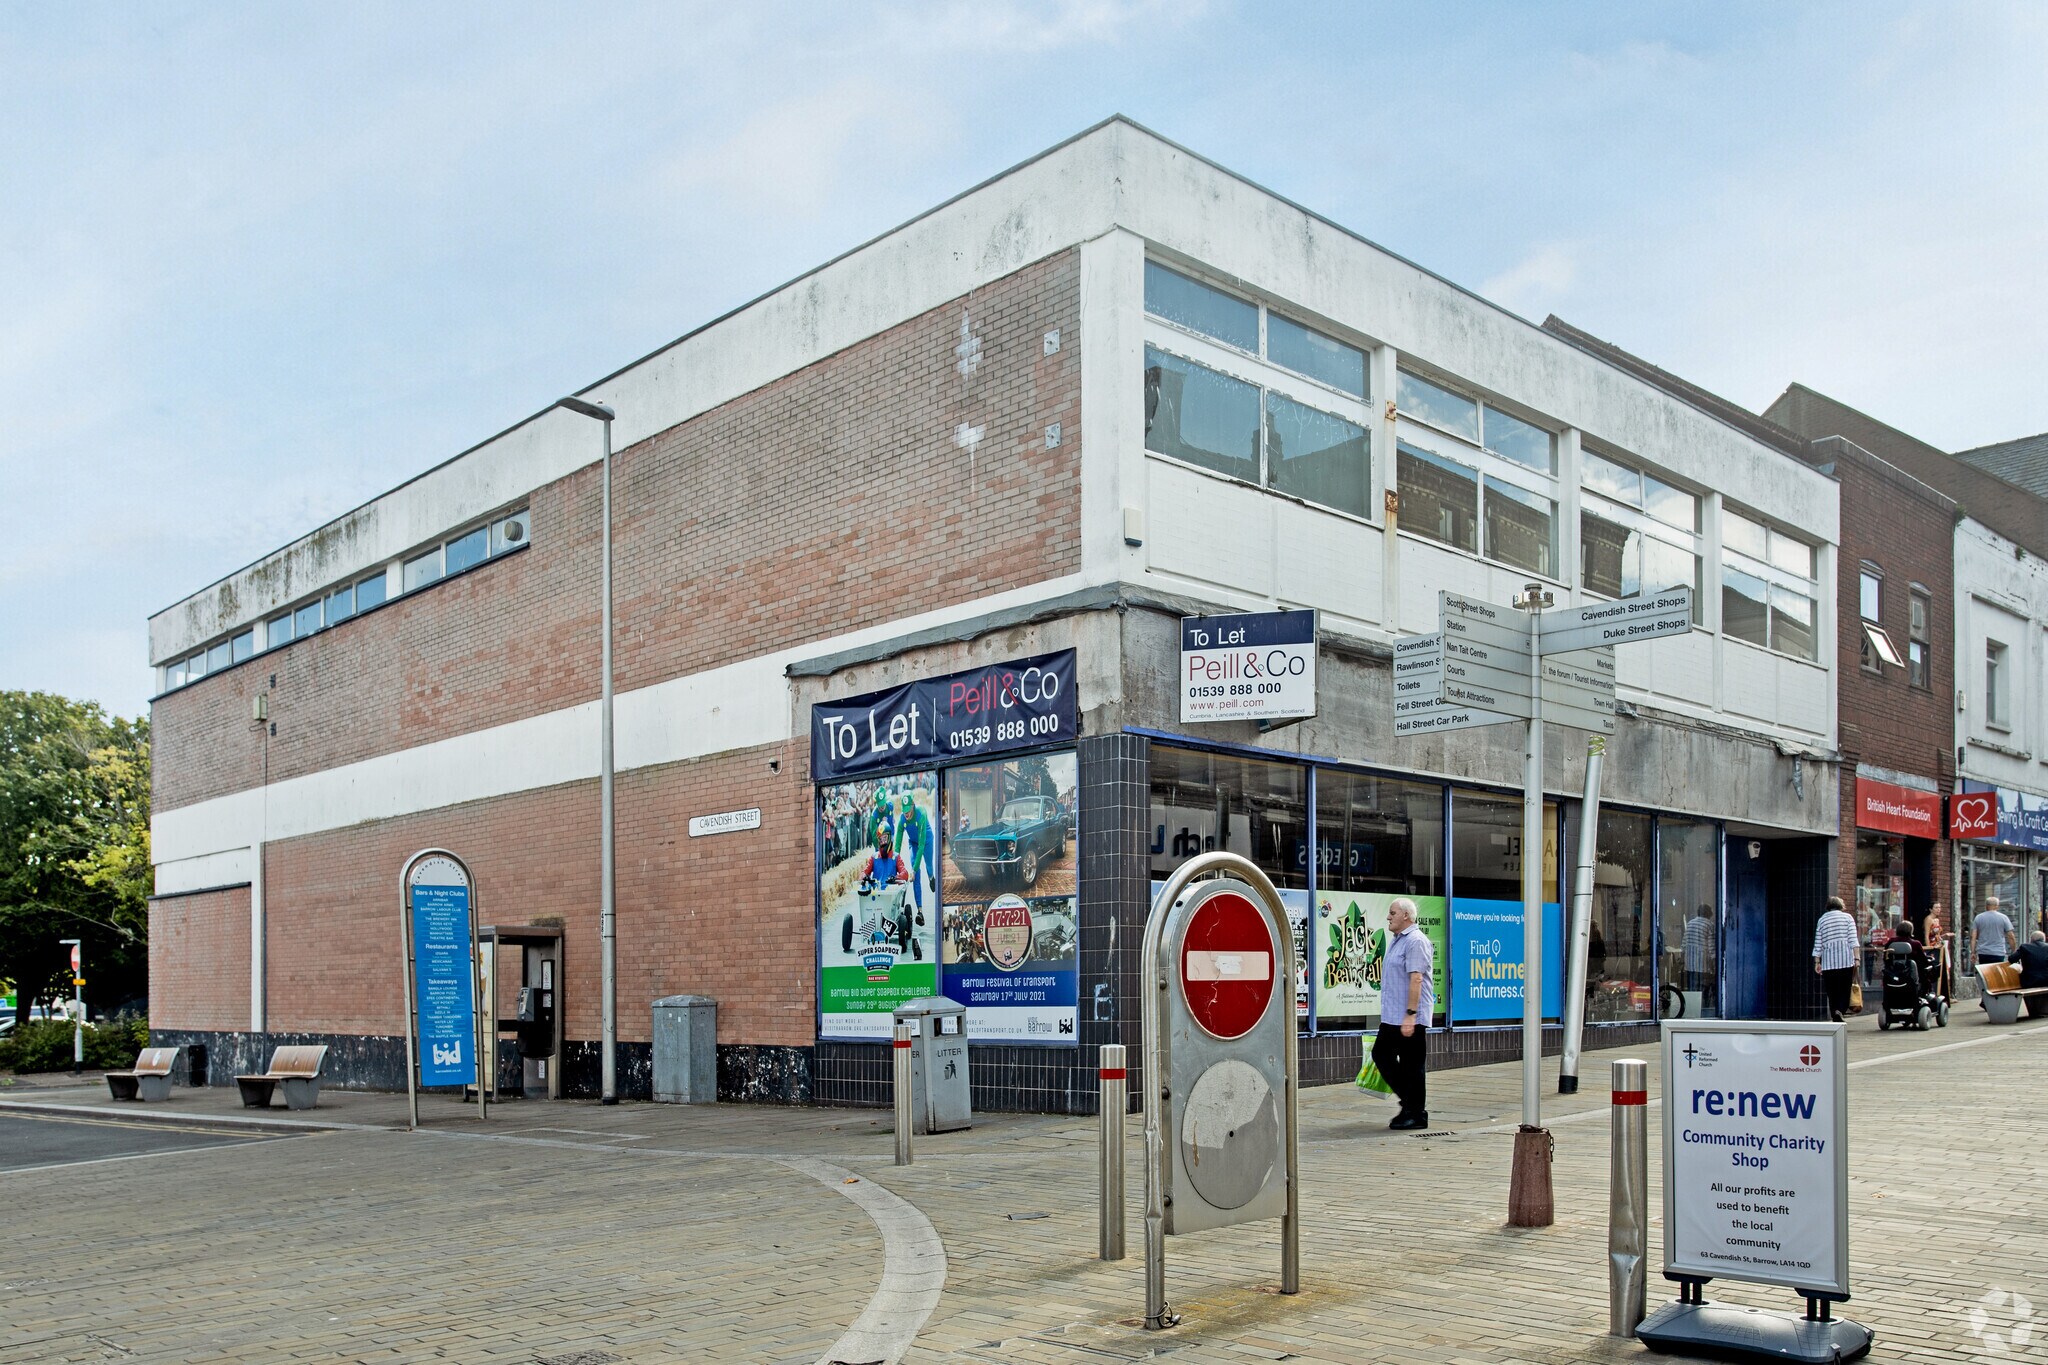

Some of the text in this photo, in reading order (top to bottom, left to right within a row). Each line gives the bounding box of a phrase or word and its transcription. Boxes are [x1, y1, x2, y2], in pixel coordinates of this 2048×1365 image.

[1446, 597, 1495, 619] Scott Street Shops
[1582, 596, 1685, 621] Cavendish Street Shops
[1447, 620, 1466, 632] Station
[1604, 618, 1685, 639] Duke Street Shops
[1190, 627, 1245, 646] To Let
[1397, 638, 1434, 652] Cavendish
[1447, 642, 1458, 652] Nan
[1459, 645, 1469, 655] Tait
[1470, 648, 1487, 659] Centre
[1397, 659, 1434, 672] Rawlinson
[1447, 665, 1465, 676] Courts
[1597, 659, 1614, 670] Markets
[1397, 681, 1420, 691] Toilets
[1557, 668, 1570, 679] forum
[1574, 673, 1589, 685] Tourist
[1590, 677, 1614, 689] Information
[1190, 683, 1281, 698] 01539 888 000
[1467, 690, 1494, 704] Attractions
[1190, 698, 1264, 711] www.peill.com
[1397, 698, 1433, 711] Fell Street
[1594, 698, 1614, 709] Town Hall
[1397, 714, 1469, 731] Hall Street Car Park
[1603, 720, 1614, 729] Taxis
[823, 703, 920, 760] To Let
[950, 714, 1059, 749] 01539 888 000
[1867, 798, 1931, 822] British Heart Foundation
[700, 815, 732, 828] CAVENDISH
[735, 811, 758, 823] STREET
[1997, 806, 2041, 831] Sewing & Craft
[1418, 917, 1440, 926] SALE NOW!
[1455, 912, 1482, 921] Whatever
[1483, 913, 1499, 923] you're
[1501, 913, 1519, 924] looking
[1333, 910, 1377, 963] Jack
[857, 946, 899, 957] SUPER SOAPBOX
[1470, 939, 1490, 955] Find
[1470, 959, 1524, 980] INfurne
[1030, 992, 1045, 1000] 2021
[937, 1048, 962, 1057] LITTER
[1692, 1089, 1816, 1119] re:new
[1683, 1129, 1825, 1153] Community Charity
[1732, 1152, 1769, 1171] Shop
[1711, 1182, 1795, 1198] All our profits are
[1717, 1201, 1789, 1215] used to benefit
[1732, 1220, 1773, 1231] the local
[1726, 1236, 1781, 1251] community
[1710, 1252, 1741, 1262] Cavendish
[1753, 1257, 1778, 1266] Barrow,
